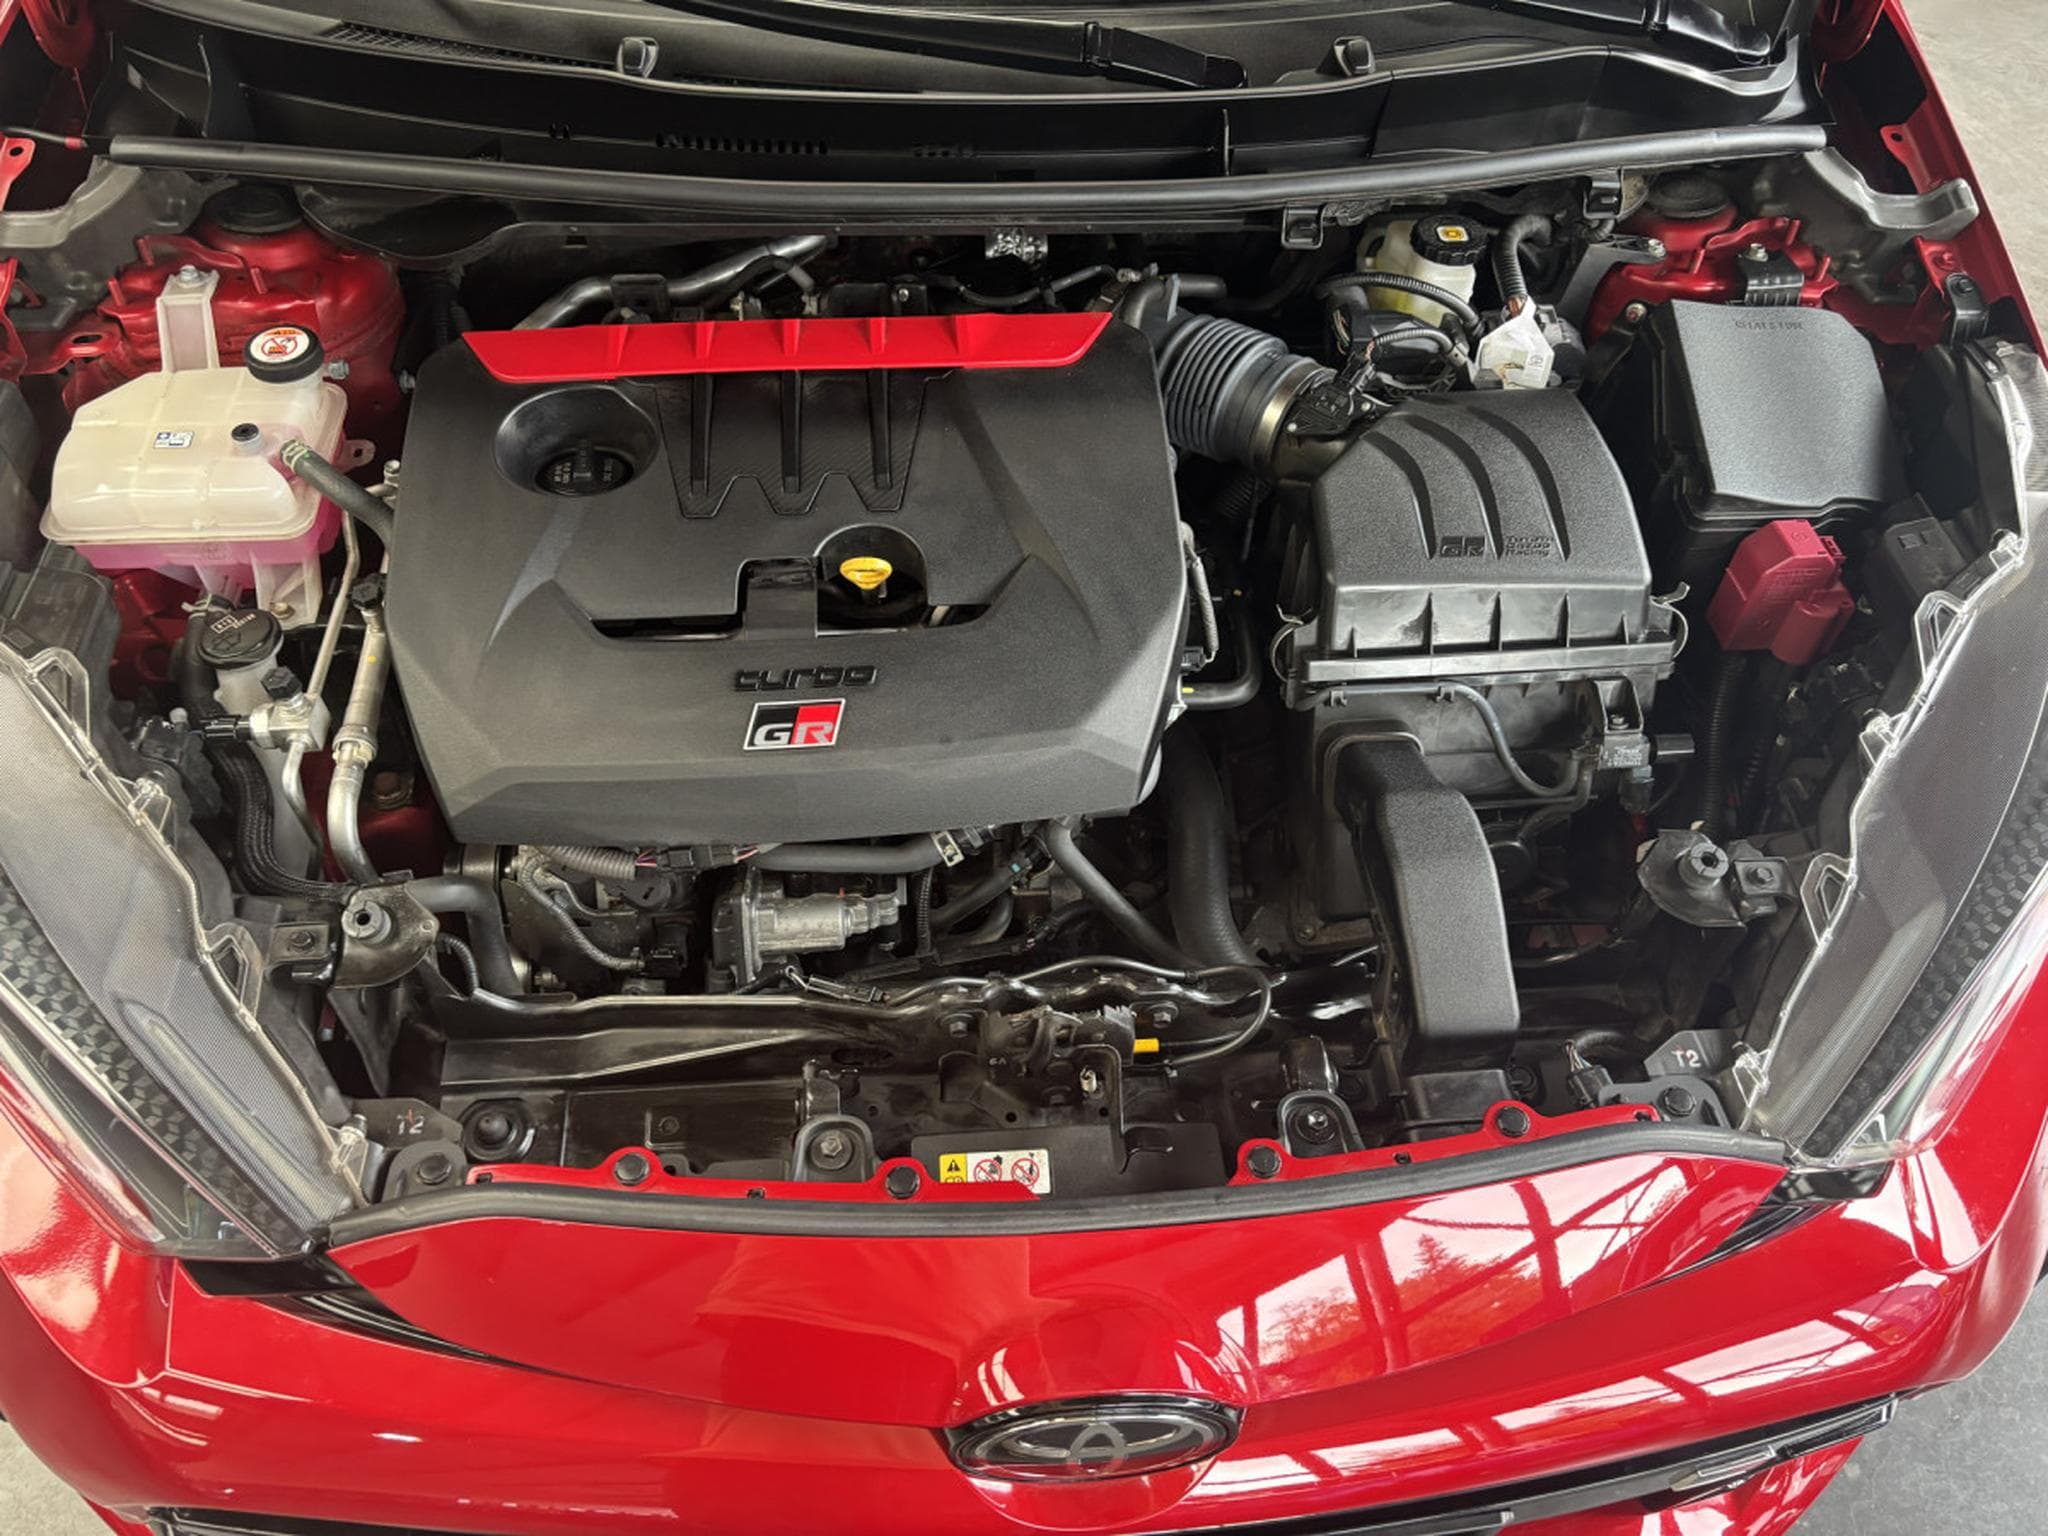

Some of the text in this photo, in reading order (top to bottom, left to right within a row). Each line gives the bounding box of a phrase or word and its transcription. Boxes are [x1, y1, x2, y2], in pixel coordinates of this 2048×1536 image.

[734, 665, 877, 691] turbo
[753, 721, 835, 747] GR
[1671, 1049, 1702, 1068] T2
